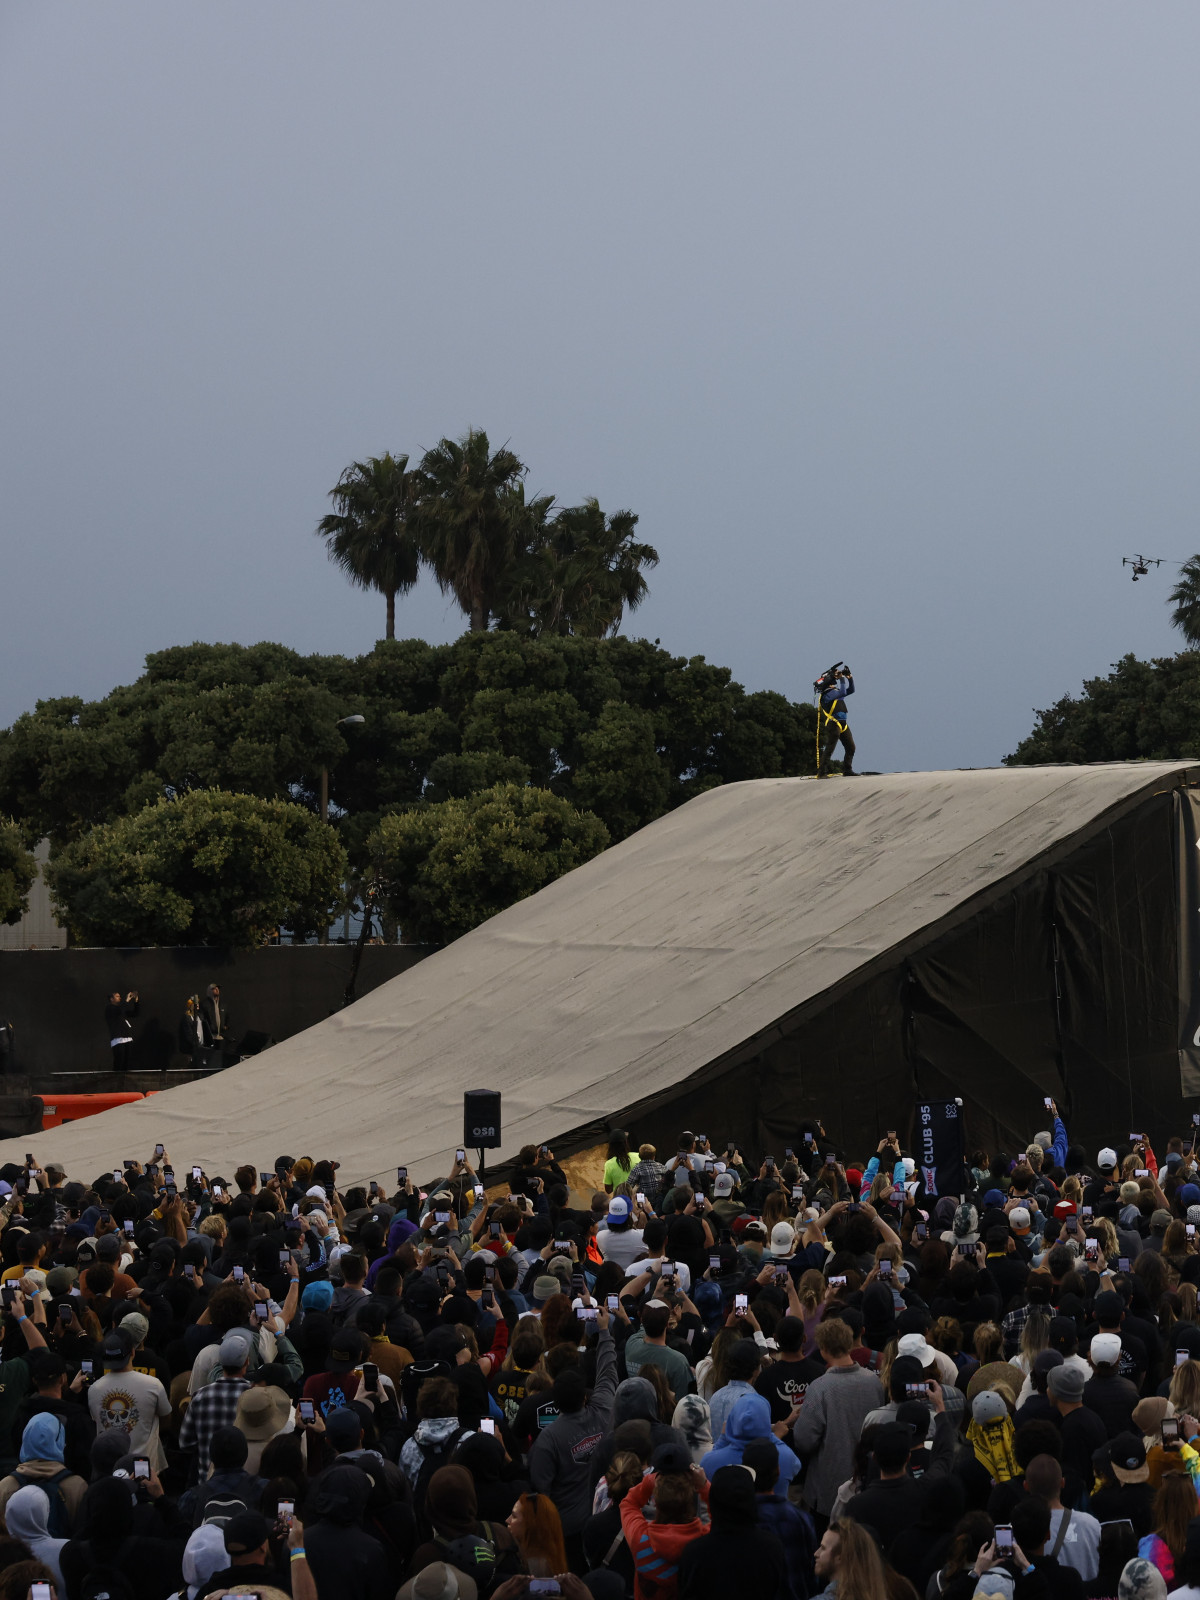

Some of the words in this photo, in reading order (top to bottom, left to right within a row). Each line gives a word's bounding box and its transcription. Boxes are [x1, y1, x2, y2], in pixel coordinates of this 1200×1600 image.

[922, 1127, 935, 1164] CLUB
[926, 1169, 934, 1193] SONIC
[497, 1384, 525, 1398] OBE
[545, 1406, 560, 1414] RV
